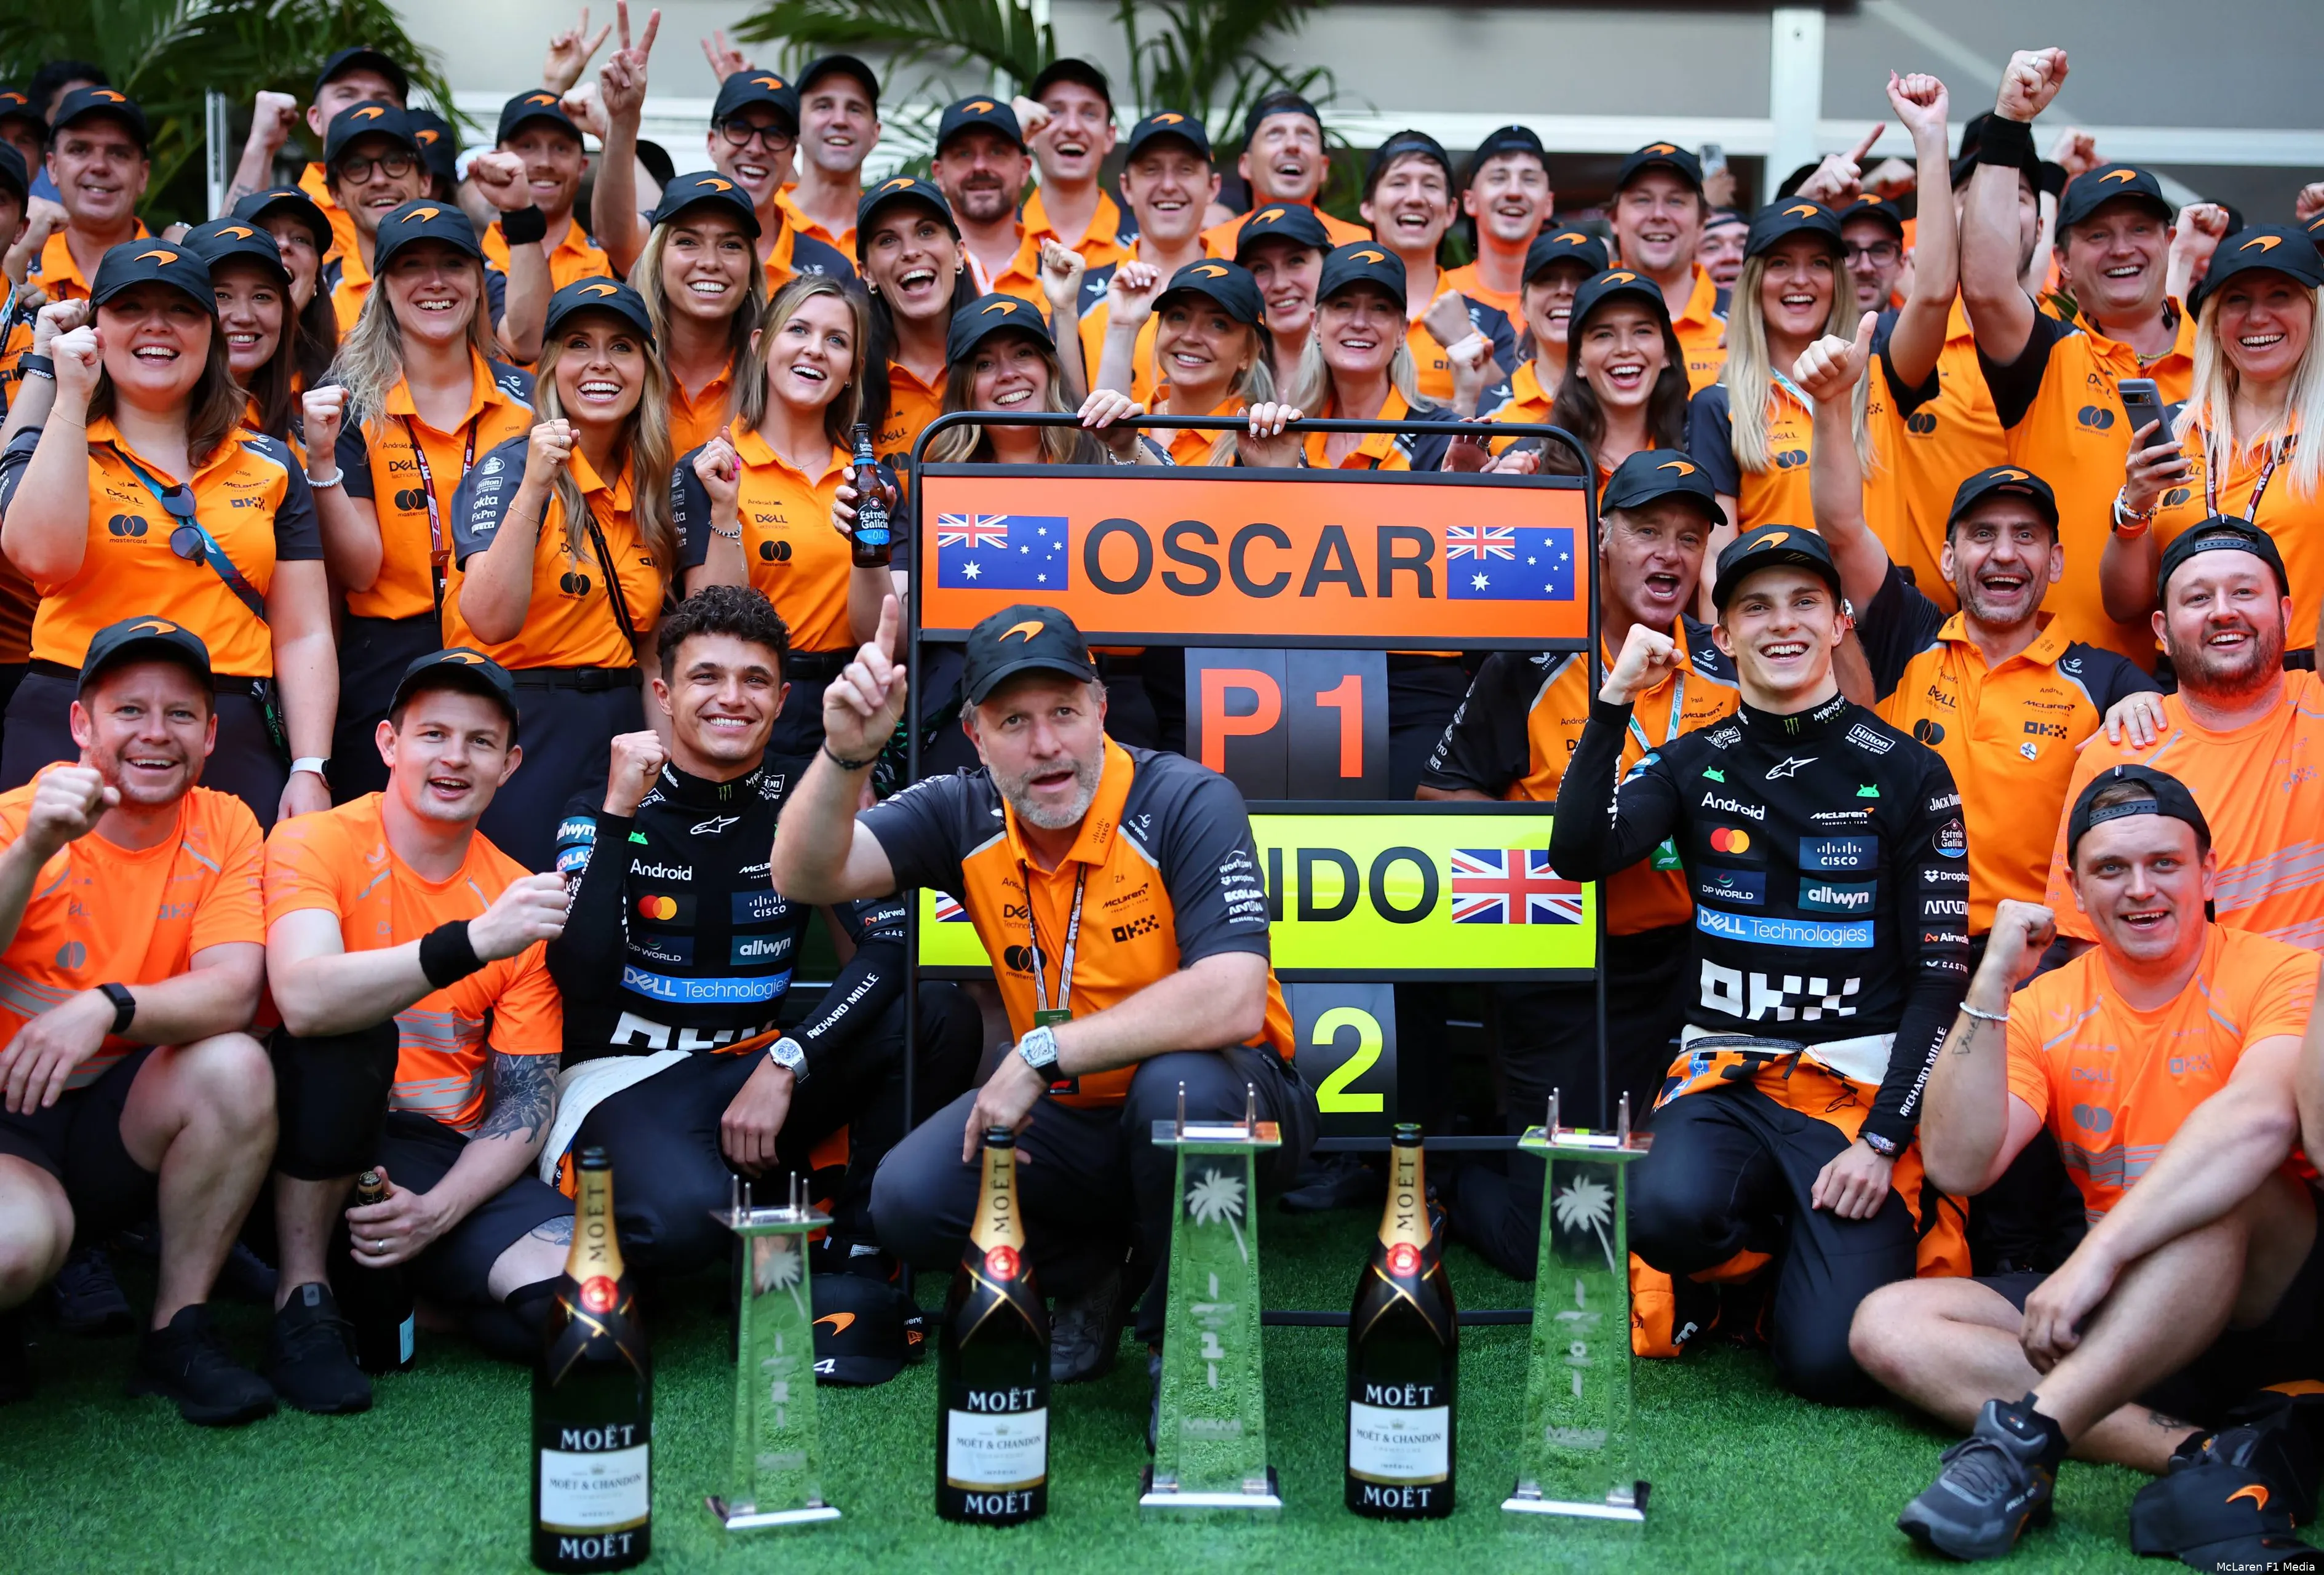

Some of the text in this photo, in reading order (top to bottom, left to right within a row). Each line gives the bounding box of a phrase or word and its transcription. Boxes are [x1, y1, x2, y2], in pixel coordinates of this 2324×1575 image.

[878, 428, 908, 444] DELL
[251, 440, 273, 452] WORLD
[223, 480, 265, 488] McLaren
[478, 480, 499, 490] Hilton
[106, 488, 143, 504] DELL
[473, 495, 498, 509] okta
[472, 510, 496, 522] FxPro
[755, 514, 788, 524] DELL
[860, 510, 888, 520] Estrella
[861, 519, 888, 529] Galicia
[1083, 517, 1436, 599] OSCAR
[1698, 658, 1718, 671] WORLD
[1928, 685, 1956, 708] DELL
[2023, 700, 2071, 711] McLaren
[1681, 706, 1721, 719] McLaren
[1854, 726, 1890, 749] Hilton
[2024, 721, 2067, 740] OKX
[1845, 735, 1857, 744] FOR
[1857, 741, 1870, 750] THE
[1701, 791, 1765, 821] Android
[1929, 796, 1949, 811] JACK
[1810, 810, 1868, 819] McLaren
[630, 858, 693, 881] Android
[1940, 871, 1969, 882] Dropbo
[1102, 888, 1146, 909] McLaren
[1224, 889, 1263, 903] ECOLAB
[1702, 884, 1753, 900] DP WORLD
[1808, 886, 1869, 909] allwyn
[1111, 914, 1160, 943] OKX
[1700, 909, 1867, 946] DELL Technologies
[628, 942, 682, 962] DP WORLD
[739, 937, 791, 956] allwyn
[624, 966, 790, 1000] DELL Technologies
[1700, 959, 1861, 1021] OKX
[806, 972, 880, 1040] RICHARD MILLE
[1311, 1006, 1384, 1113] 2
[1899, 1026, 1947, 1117] RICHARD MILLE
[2071, 1067, 2115, 1083] DELL
[813, 1358, 835, 1374] 4
[967, 1387, 1036, 1412] MOËT
[1365, 1383, 1433, 1406] MOËT
[560, 1423, 635, 1451] MOËT
[986, 1440, 995, 1449] &
[997, 1435, 1041, 1449] CHANDON
[1383, 1434, 1390, 1443] &
[1393, 1432, 1441, 1444] CHANDON
[581, 1482, 589, 1491] &
[592, 1473, 642, 1490] CHANDON
[964, 1490, 1033, 1515] MOËT
[1363, 1484, 1431, 1508] MOËT
[558, 1531, 633, 1560] MOËT
